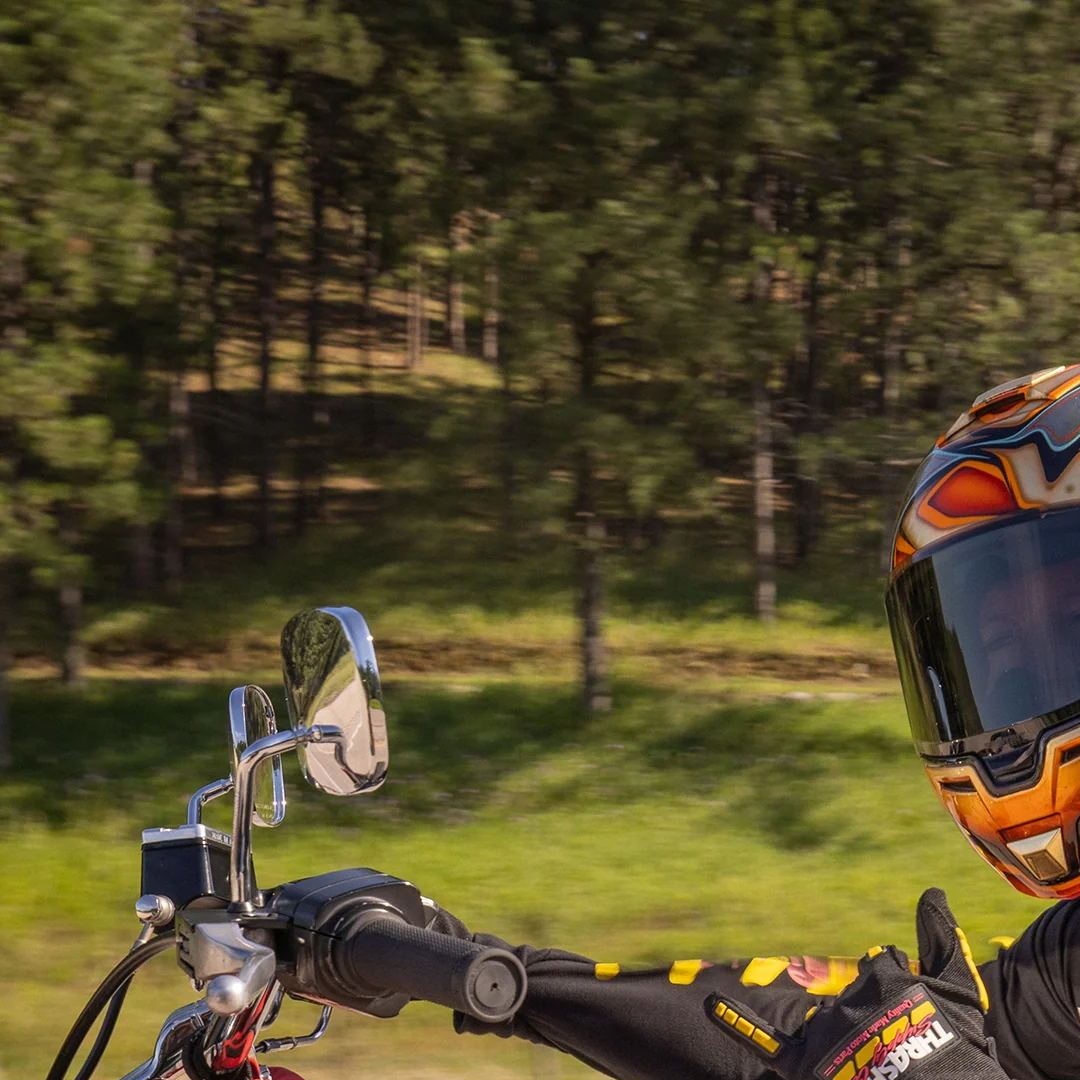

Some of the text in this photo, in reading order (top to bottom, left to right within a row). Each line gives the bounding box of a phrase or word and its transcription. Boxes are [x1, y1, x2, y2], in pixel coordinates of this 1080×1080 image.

[833, 999, 913, 1065] Quality Made Moto Parts
[872, 1013, 934, 1066] Supply
